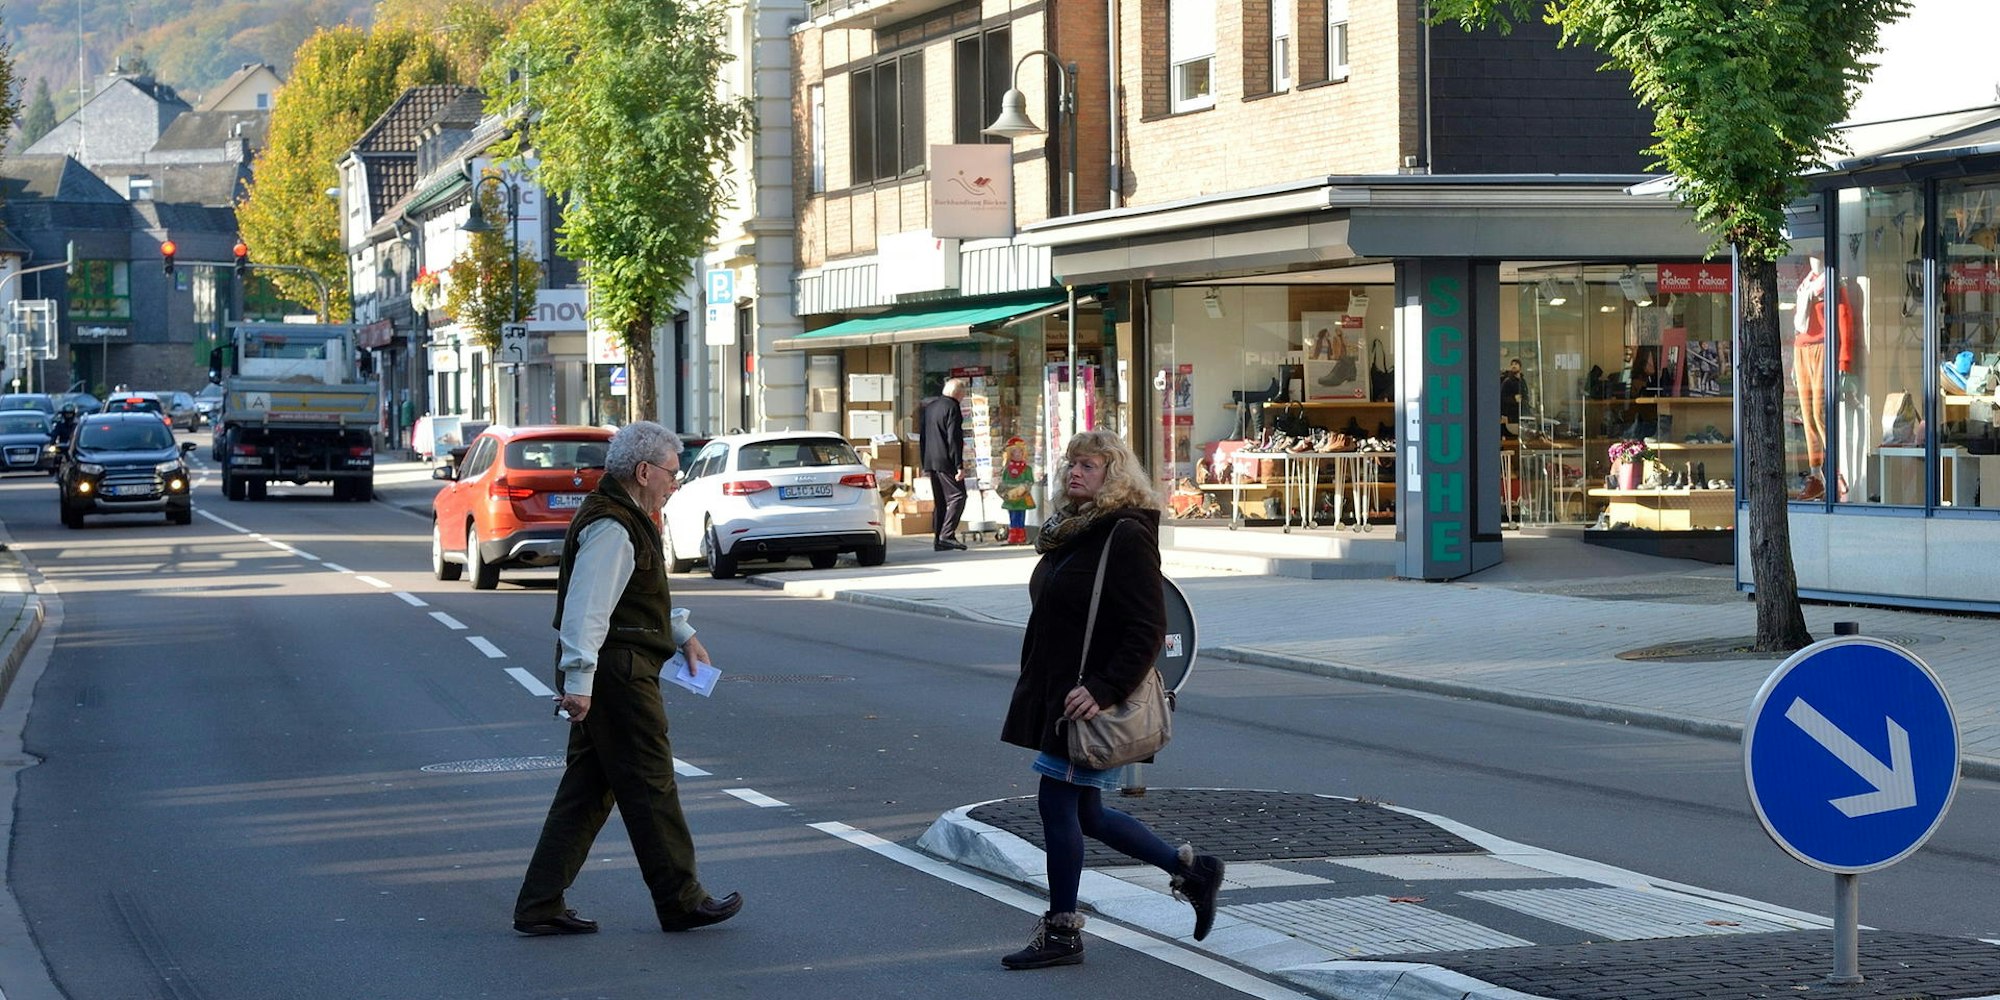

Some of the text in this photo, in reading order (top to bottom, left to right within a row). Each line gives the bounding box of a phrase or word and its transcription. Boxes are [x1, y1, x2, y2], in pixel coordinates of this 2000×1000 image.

[1661, 276, 1691, 285] rieker
[1698, 276, 1728, 285] rieker
[713, 274, 728, 302] P
[540, 302, 589, 321] nov
[253, 396, 265, 408] A
[1427, 276, 1462, 562] SCHUHE
[786, 487, 797, 496] GL
[811, 484, 831, 495] 1405
